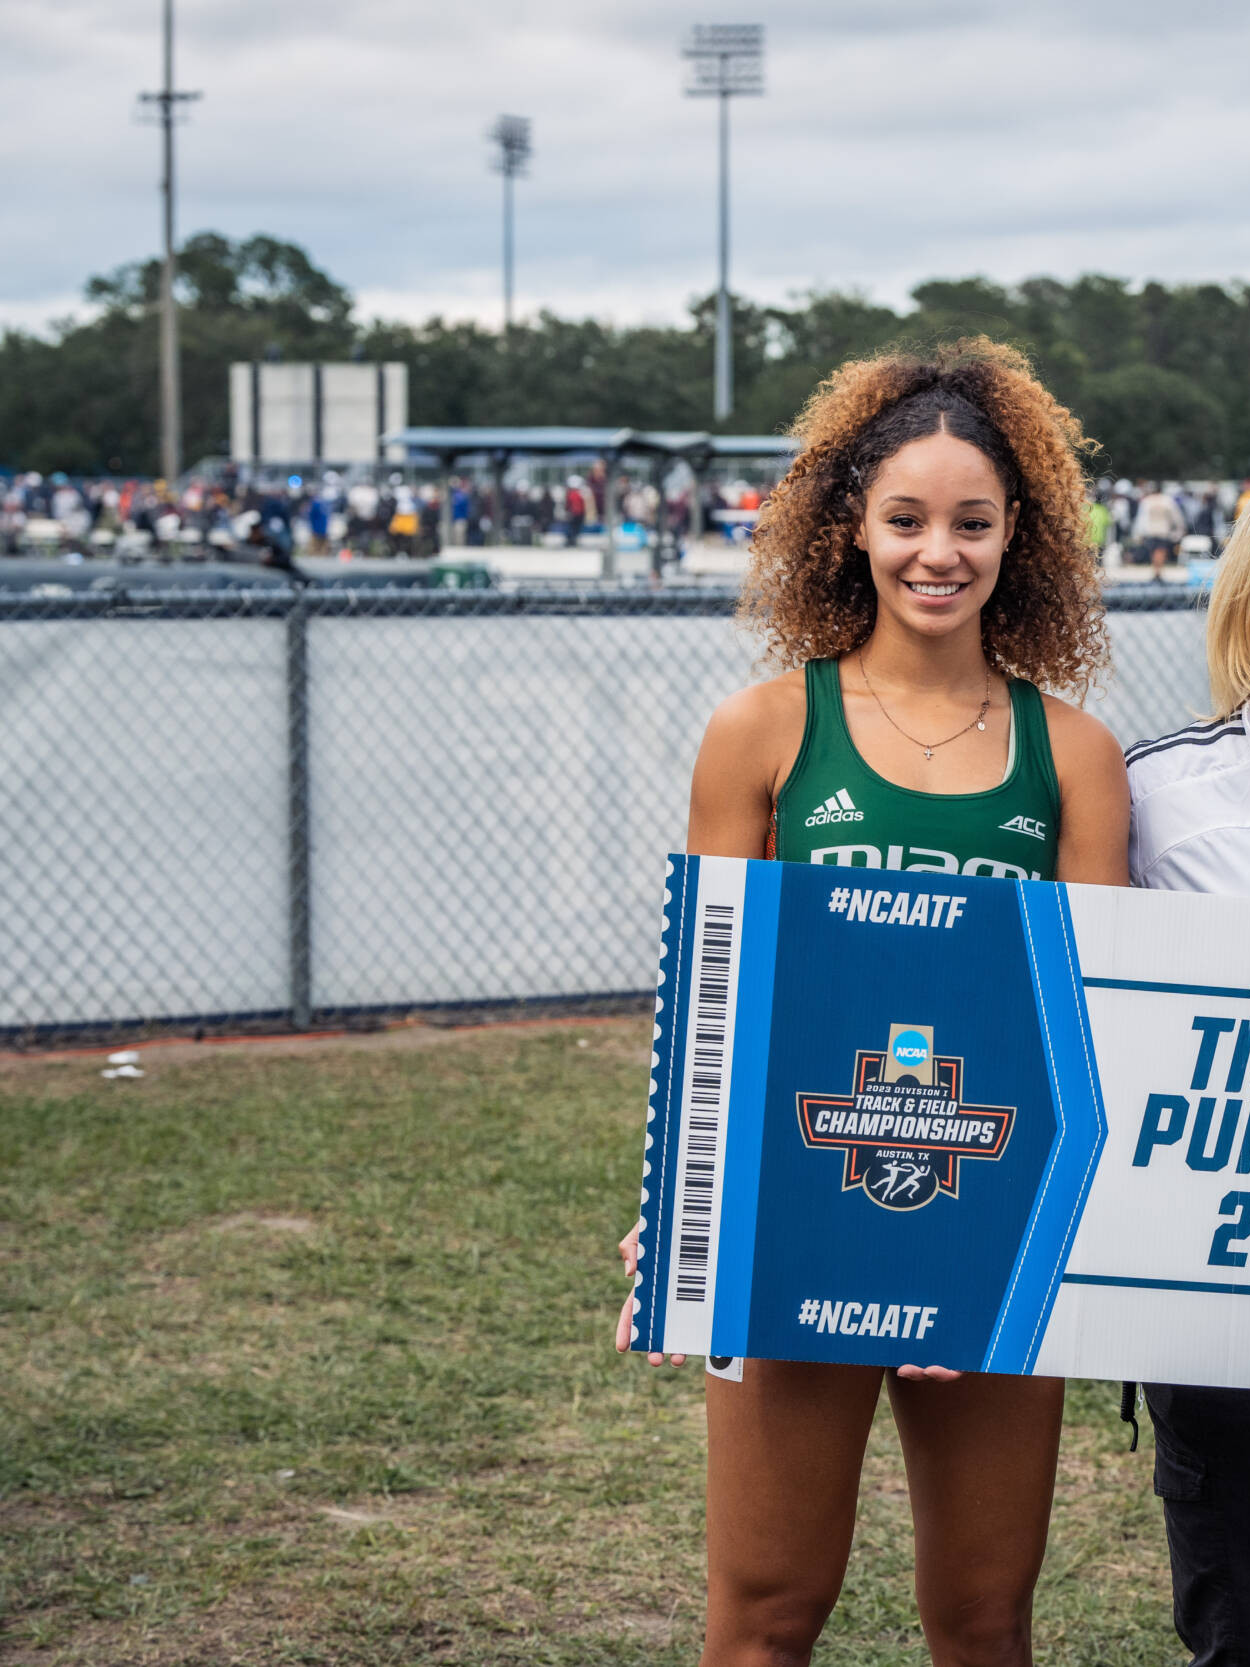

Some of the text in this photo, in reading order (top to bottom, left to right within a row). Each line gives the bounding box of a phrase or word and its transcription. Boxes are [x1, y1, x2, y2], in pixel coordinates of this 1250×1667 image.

[805, 809, 864, 827] adidas
[1003, 815, 1047, 838] ACC
[828, 886, 967, 929] #NCAATF
[896, 1047, 928, 1059] NCAA
[866, 1085, 892, 1093] 2023
[894, 1086, 940, 1097] DIVISION
[855, 1095, 958, 1116] TRACK & FIELD
[815, 1110, 996, 1144] CHAMPIONSHIPS
[875, 1150, 930, 1161] AUSTIN, TX
[798, 1299, 939, 1340] #NCAATF
